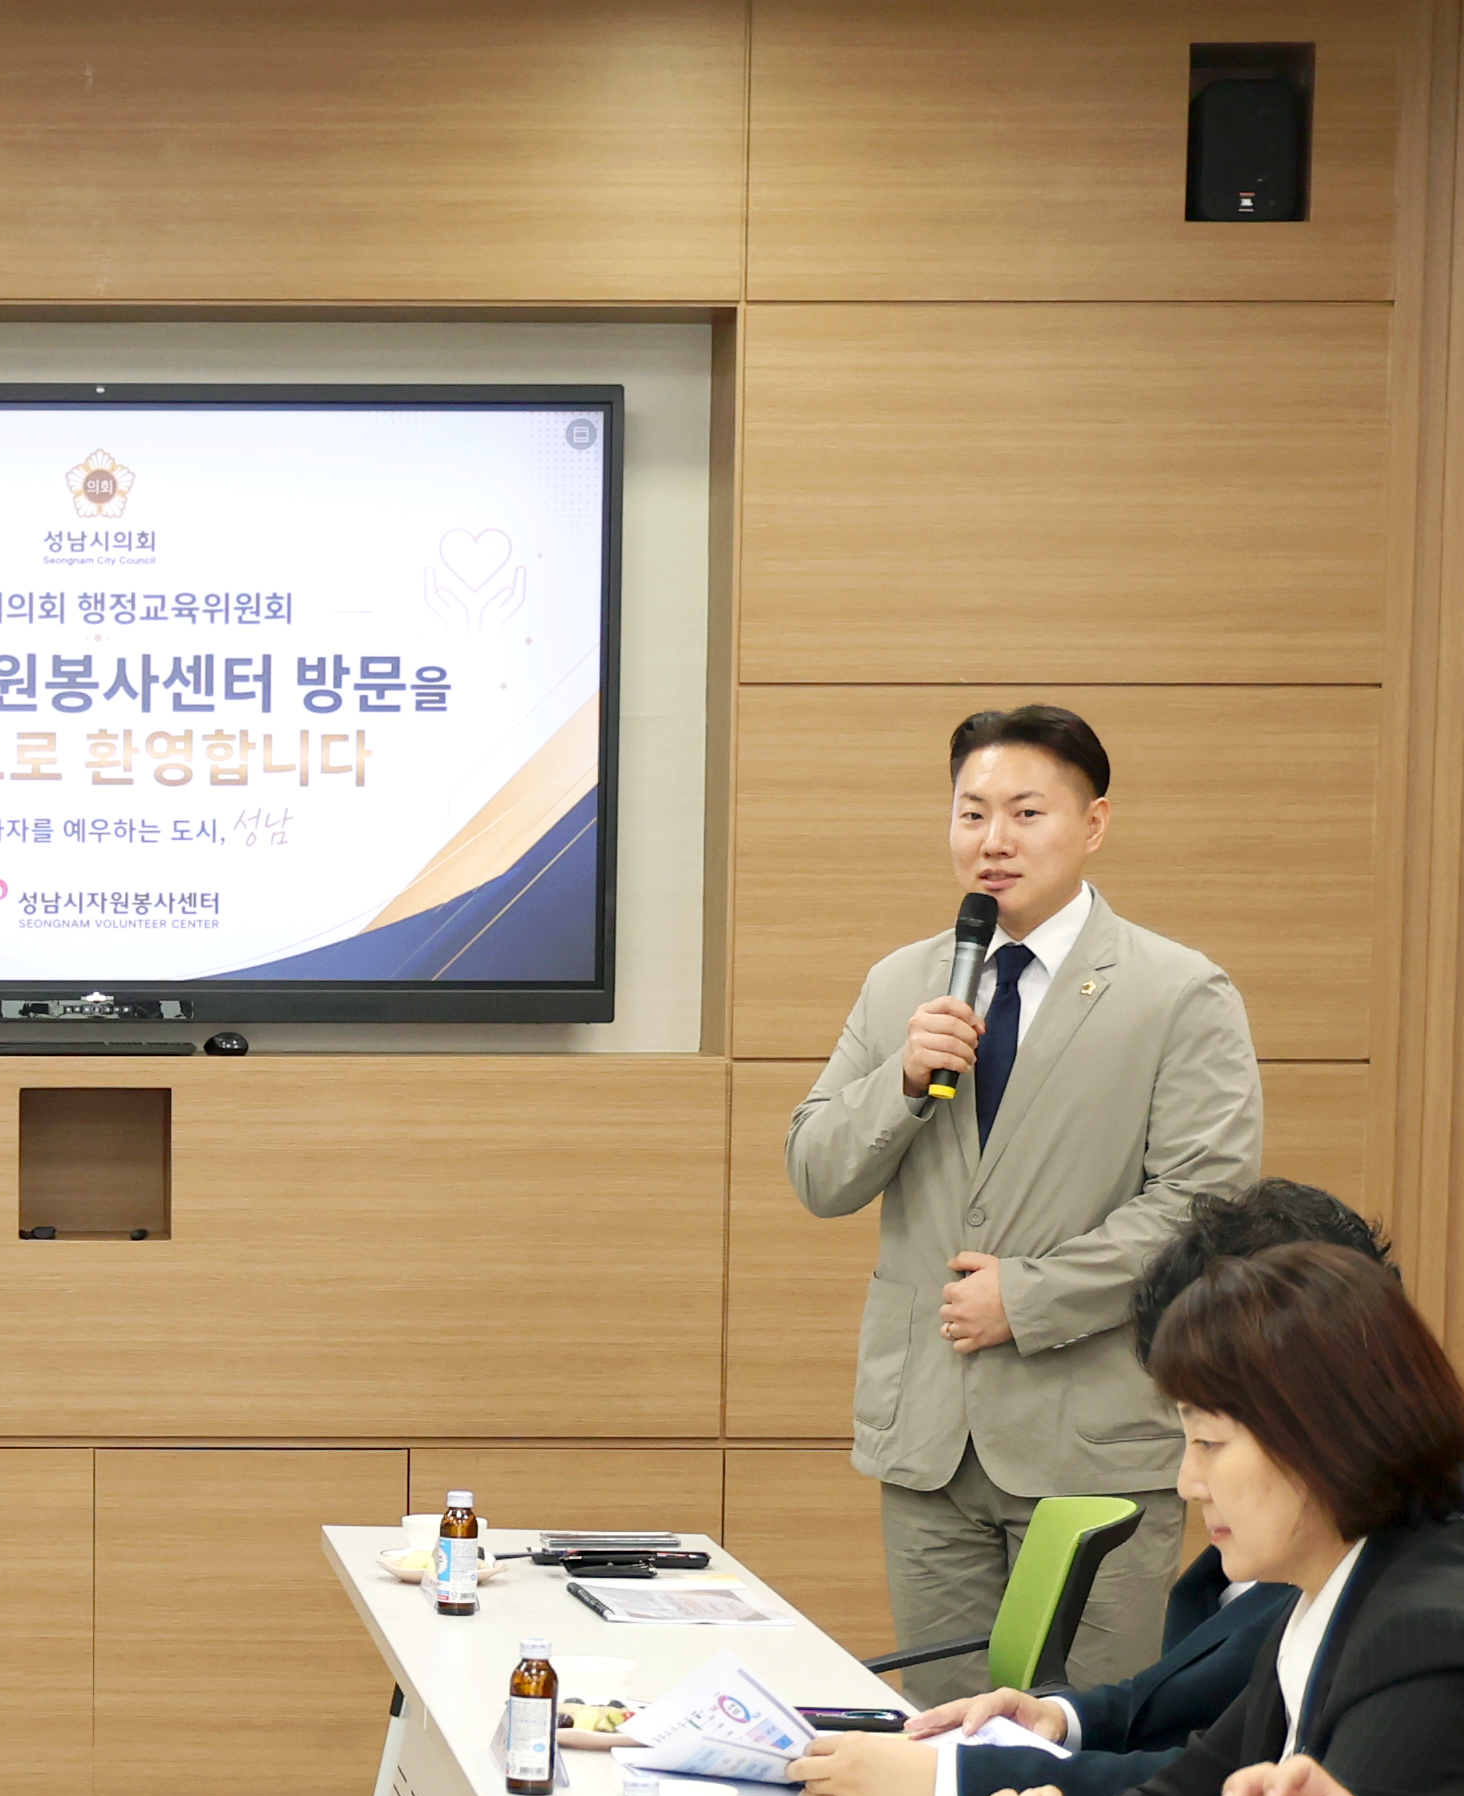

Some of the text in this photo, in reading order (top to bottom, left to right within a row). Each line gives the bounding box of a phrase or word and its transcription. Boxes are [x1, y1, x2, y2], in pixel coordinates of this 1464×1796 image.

[86, 479, 114, 495] 의회
[44, 530, 155, 553] 성남시의회
[43, 556, 156, 567] Seongnam City Council
[77, 592, 292, 625] 행정교육위원회
[296, 653, 452, 714] 방문을
[84, 728, 372, 787] 환영합니다
[62, 817, 161, 844] 예우하는
[170, 817, 226, 846] 도시,
[233, 807, 295, 847] 성남
[18, 891, 220, 915] 성남시자원봉사센터
[18, 919, 220, 929] SEONGNAM VOLUNTEER CENTER
